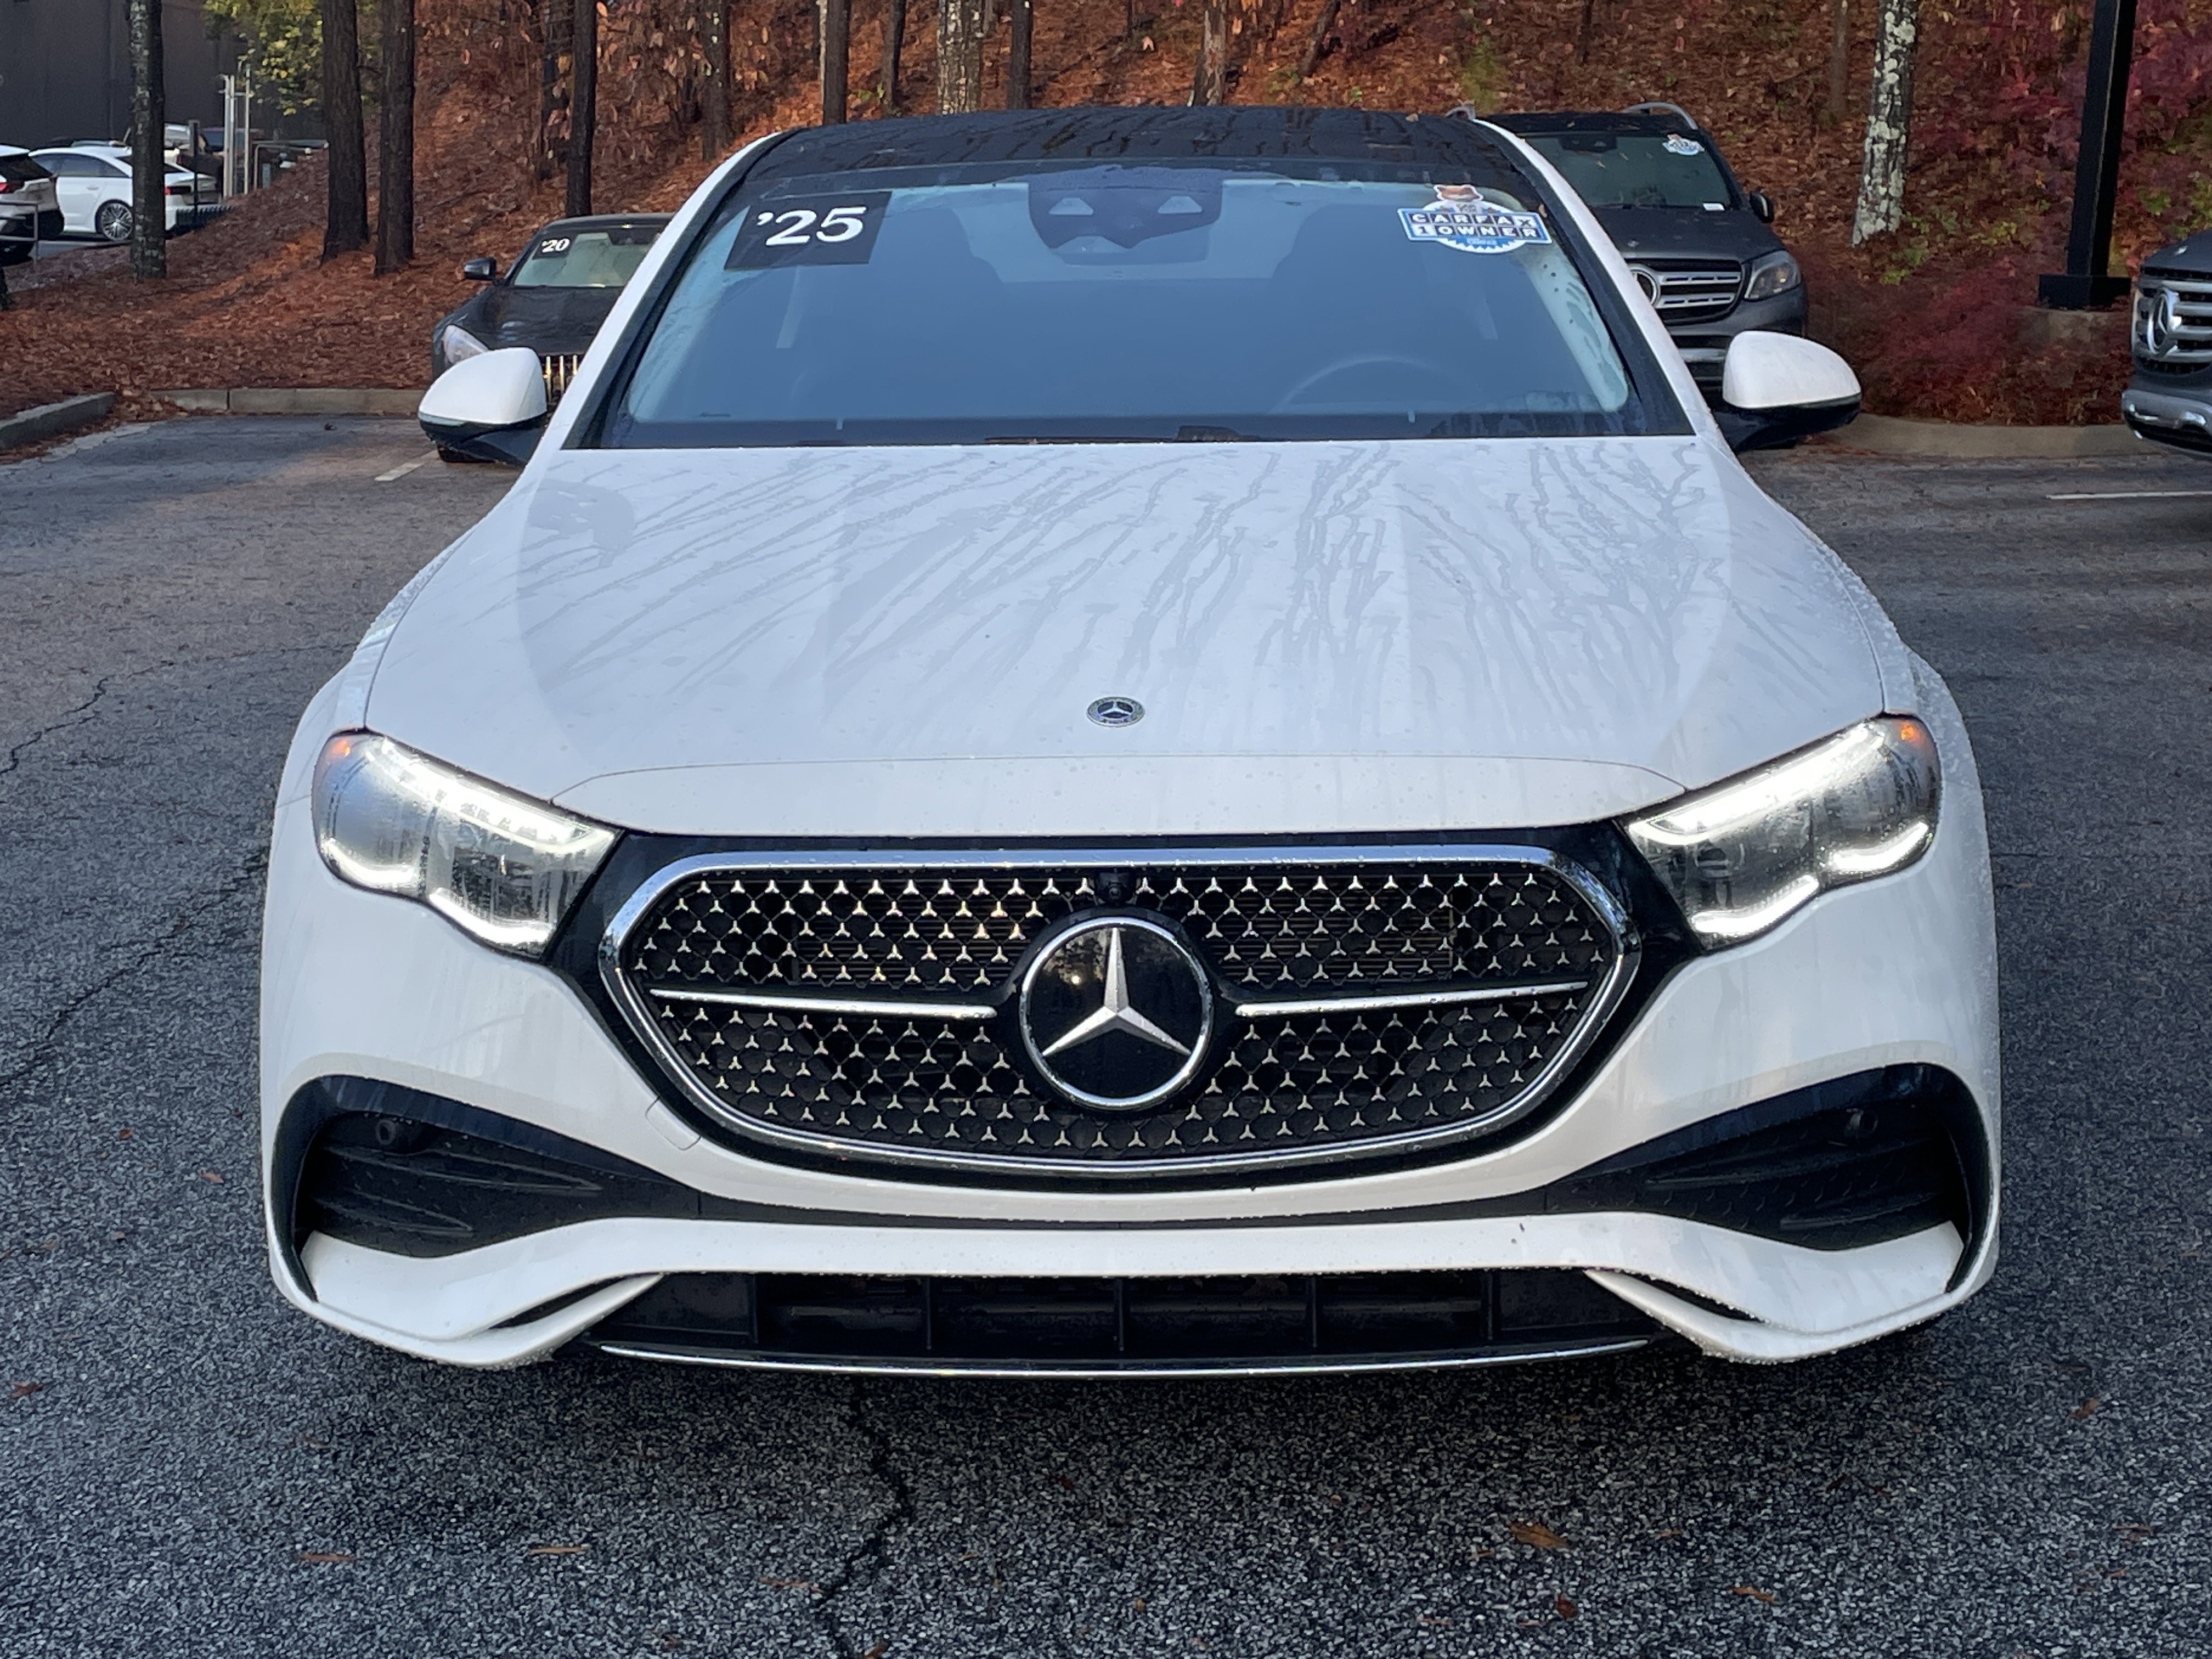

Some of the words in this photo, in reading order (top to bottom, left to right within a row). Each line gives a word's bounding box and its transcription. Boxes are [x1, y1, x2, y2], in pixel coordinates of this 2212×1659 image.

[757, 206, 867, 246] '25
[1411, 213, 1533, 227] CARFAX
[1417, 225, 1430, 235] 1
[1438, 225, 1537, 237] OWNER
